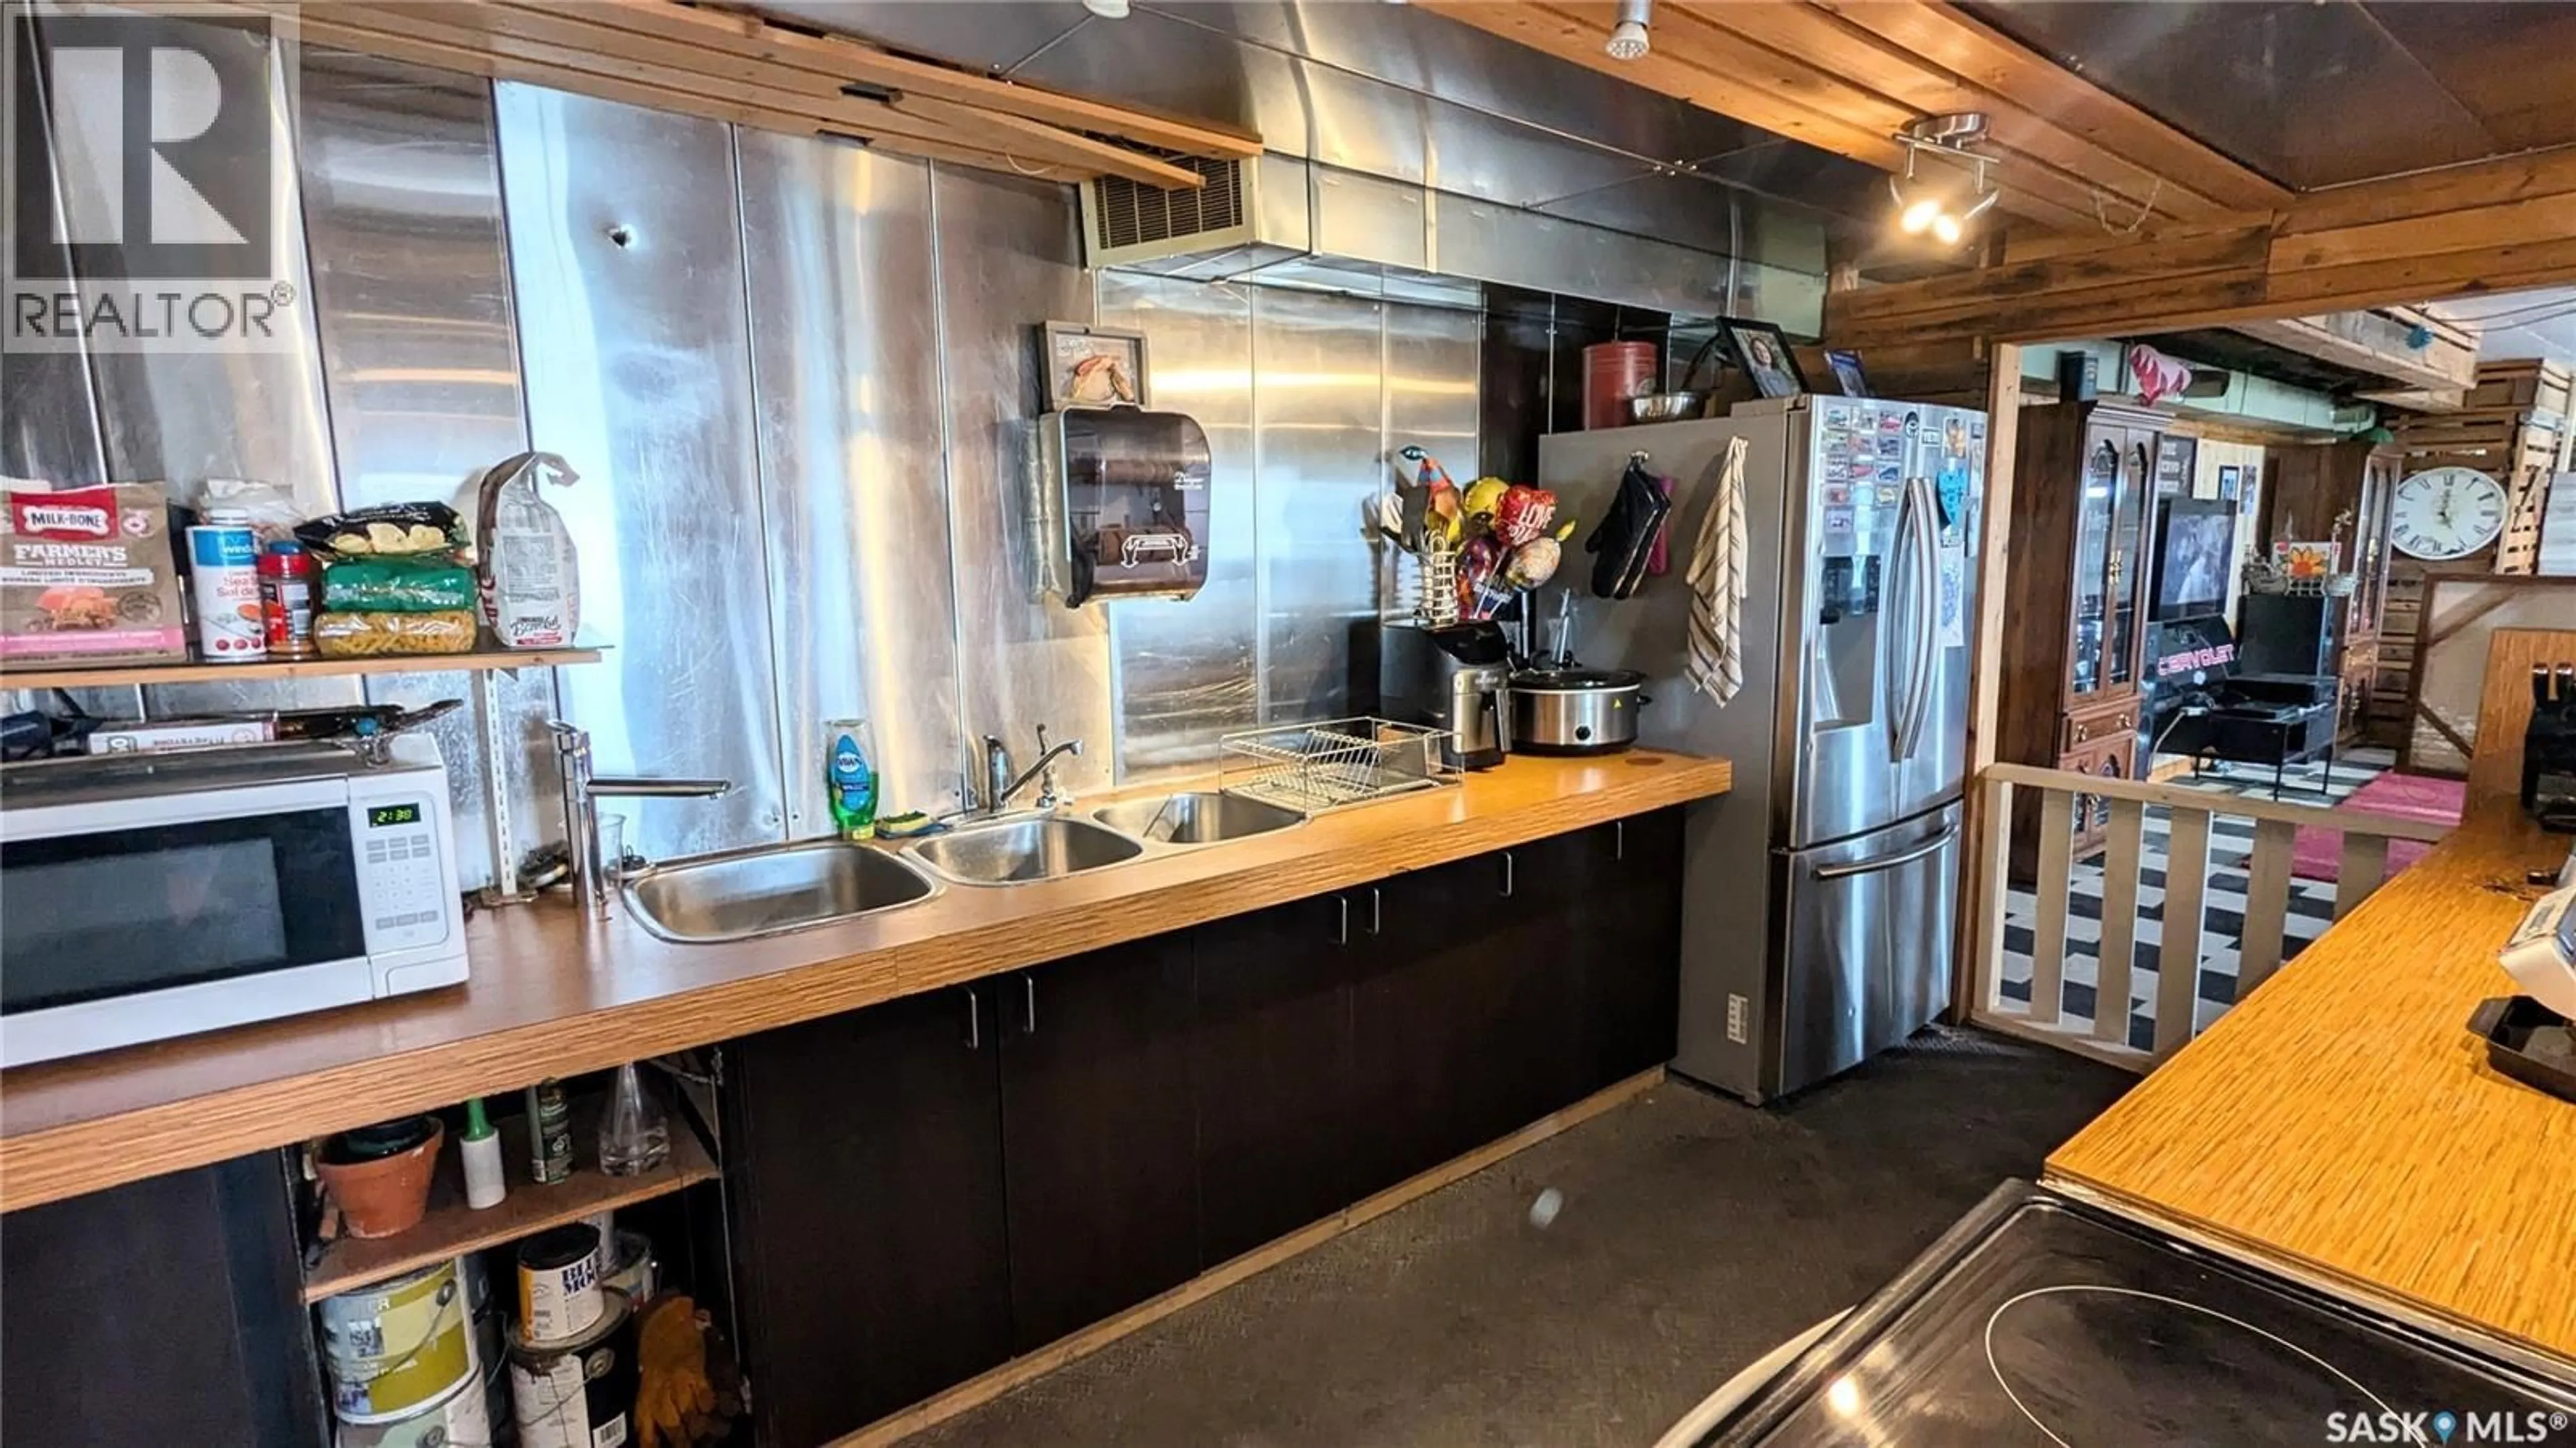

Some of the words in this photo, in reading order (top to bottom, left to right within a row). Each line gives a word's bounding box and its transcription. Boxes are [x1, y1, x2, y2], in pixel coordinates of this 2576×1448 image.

[31, 512, 101, 528] MILK-BONE
[1517, 503, 1556, 529] LOVE
[13, 544, 127, 562] FARMER'S
